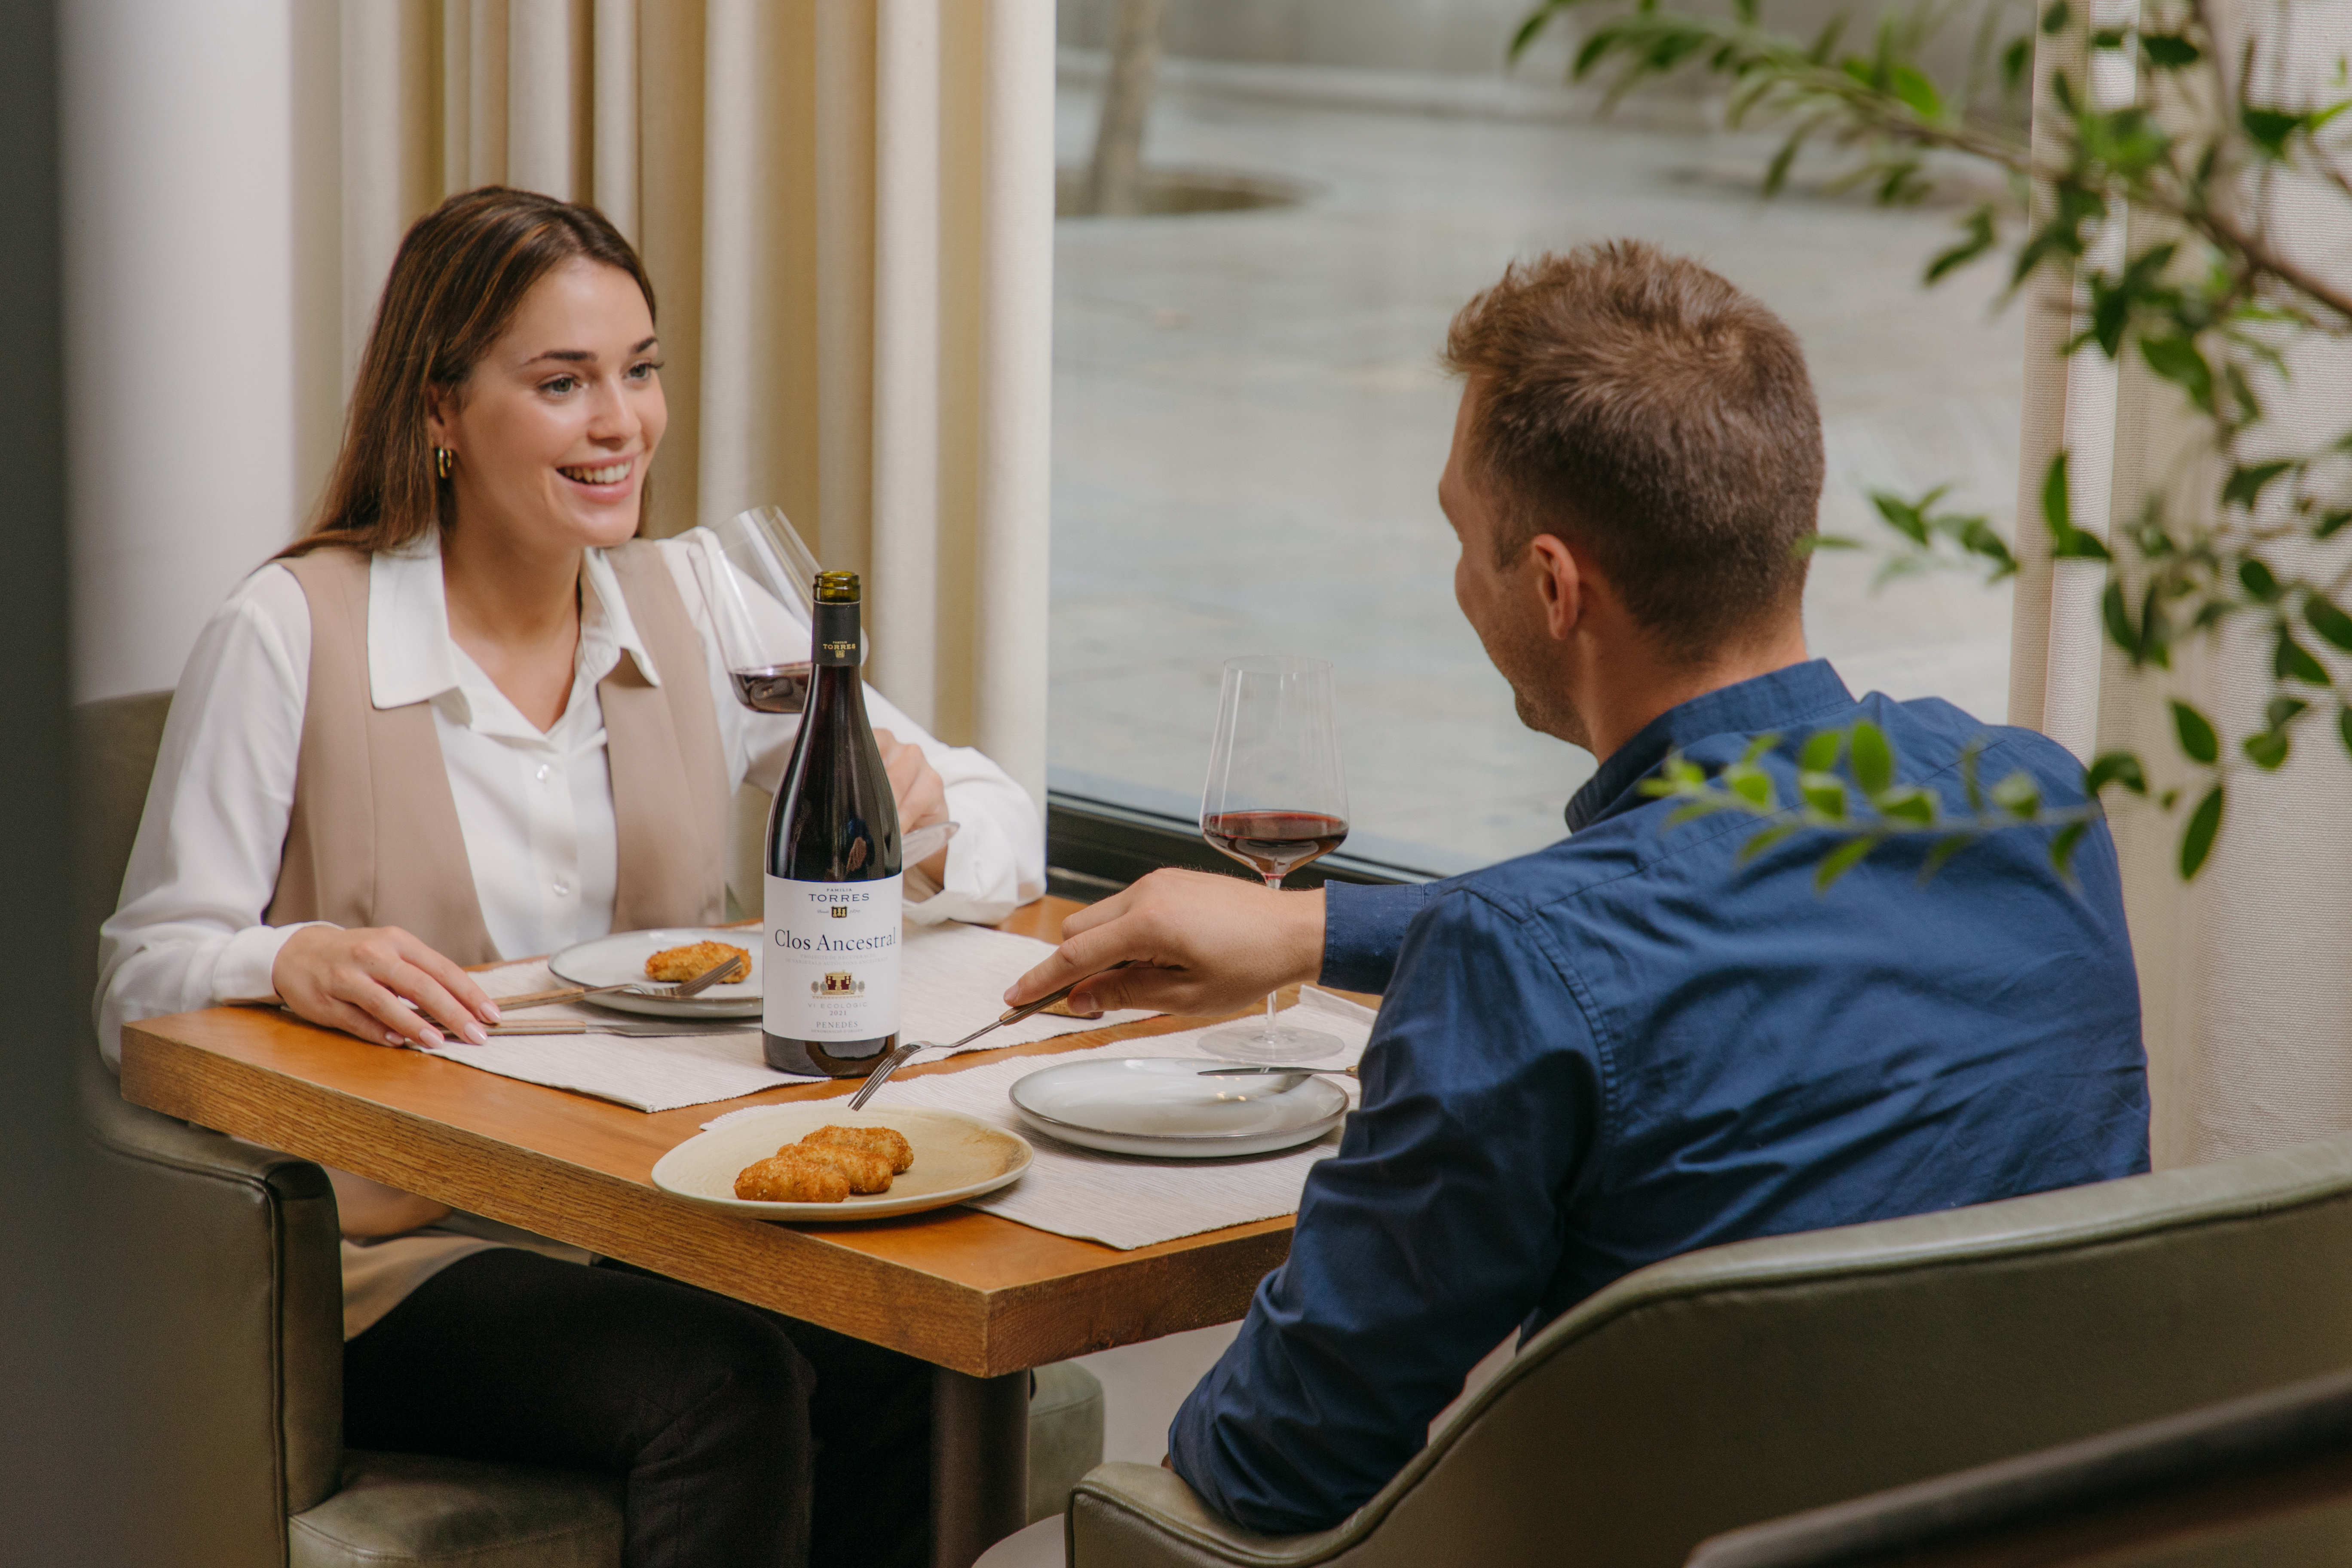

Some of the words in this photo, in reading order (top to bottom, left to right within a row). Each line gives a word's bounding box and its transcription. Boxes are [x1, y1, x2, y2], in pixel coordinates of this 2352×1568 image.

[808, 893, 869, 902] TORRES
[775, 929, 811, 949] Clos
[816, 927, 896, 951] Ancestral
[816, 1020, 858, 1028] PENEDÈS
